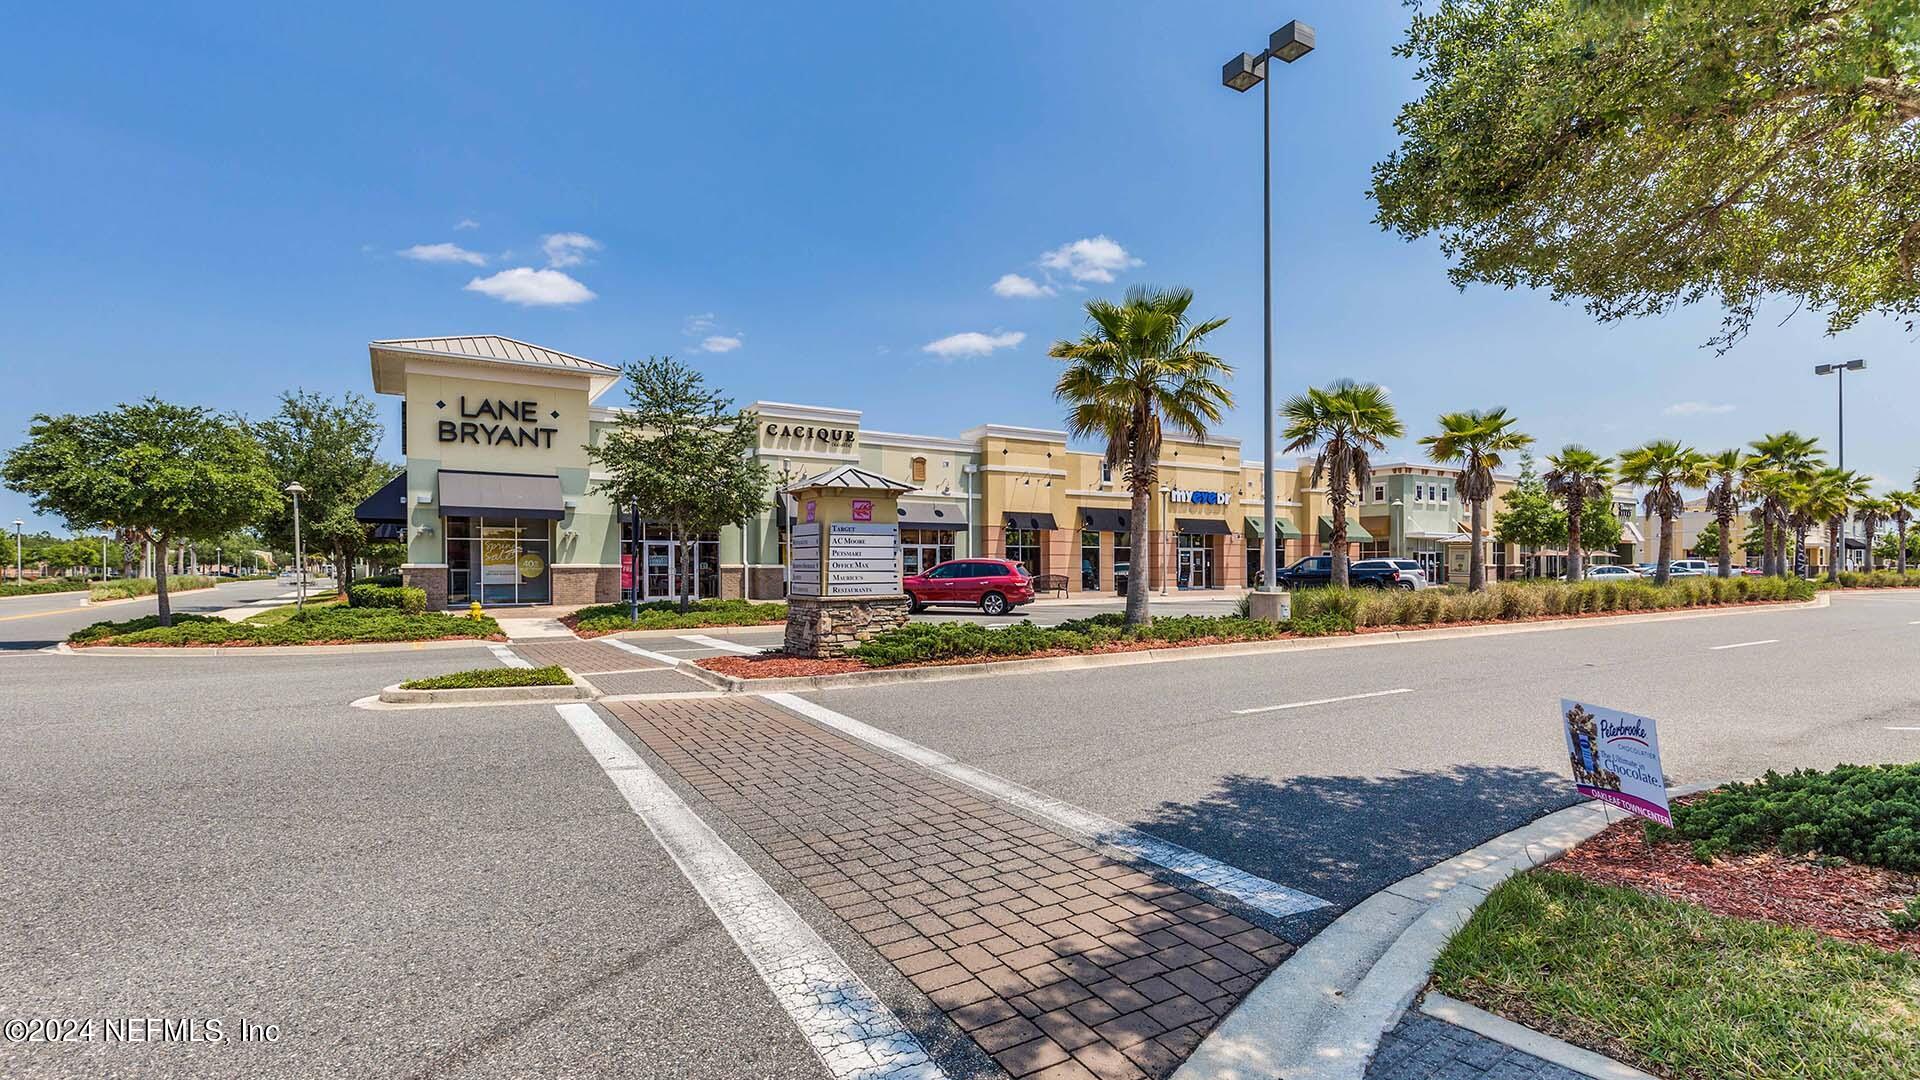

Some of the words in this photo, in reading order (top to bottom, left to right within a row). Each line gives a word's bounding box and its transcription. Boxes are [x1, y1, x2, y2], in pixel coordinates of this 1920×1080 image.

[460, 396, 538, 422] LANE
[438, 420, 558, 448] BRYANT
[766, 424, 855, 443] CACIQUE
[1600, 718, 1648, 739] Peterbrooke
[1591, 789, 1621, 807] OAKLEAF
